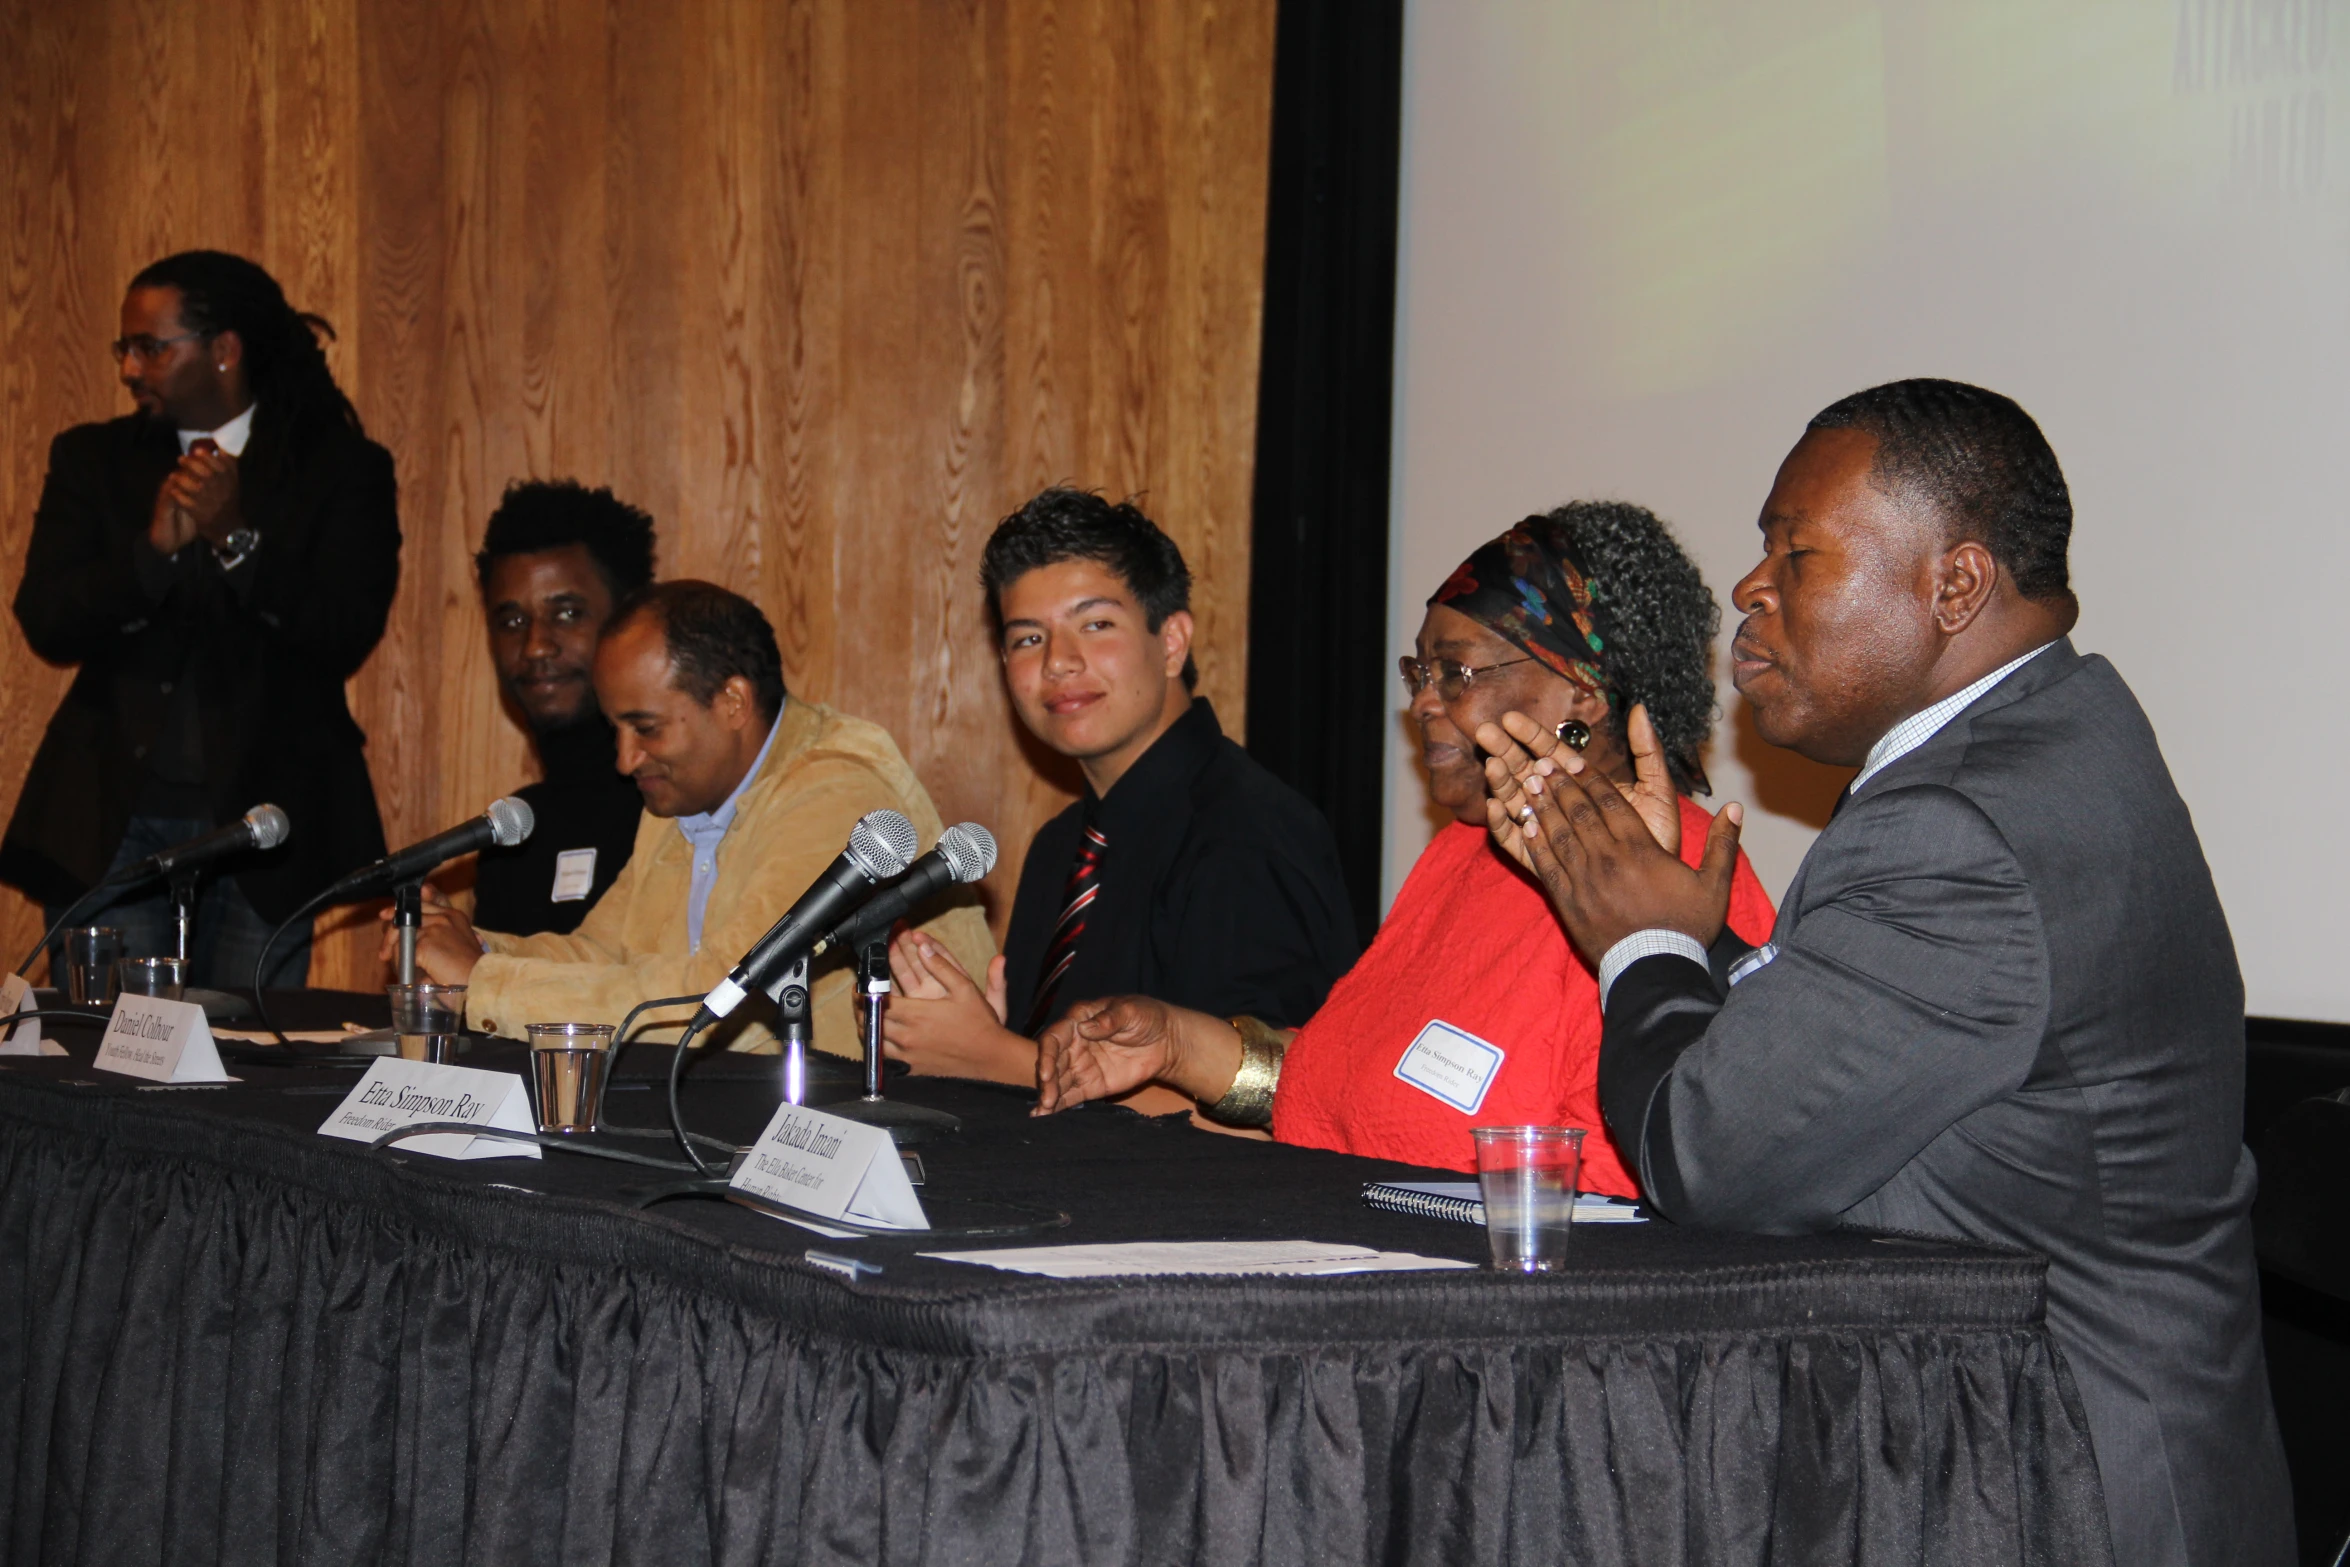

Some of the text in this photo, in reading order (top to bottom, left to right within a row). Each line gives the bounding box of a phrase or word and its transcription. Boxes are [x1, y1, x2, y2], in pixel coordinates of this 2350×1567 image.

[114, 1010, 174, 1042] Daniel Colhour
[1415, 1043, 1484, 1084] Etta Simpson Ray
[1420, 1064, 1460, 1088] Freedom Rider
[339, 1111, 396, 1131] Freedom Rider
[359, 1081, 485, 1124] Etta Simpson Ray
[771, 1114, 848, 1160] Jakada Imani
[754, 1153, 824, 1190] The Ella Baker Center for
